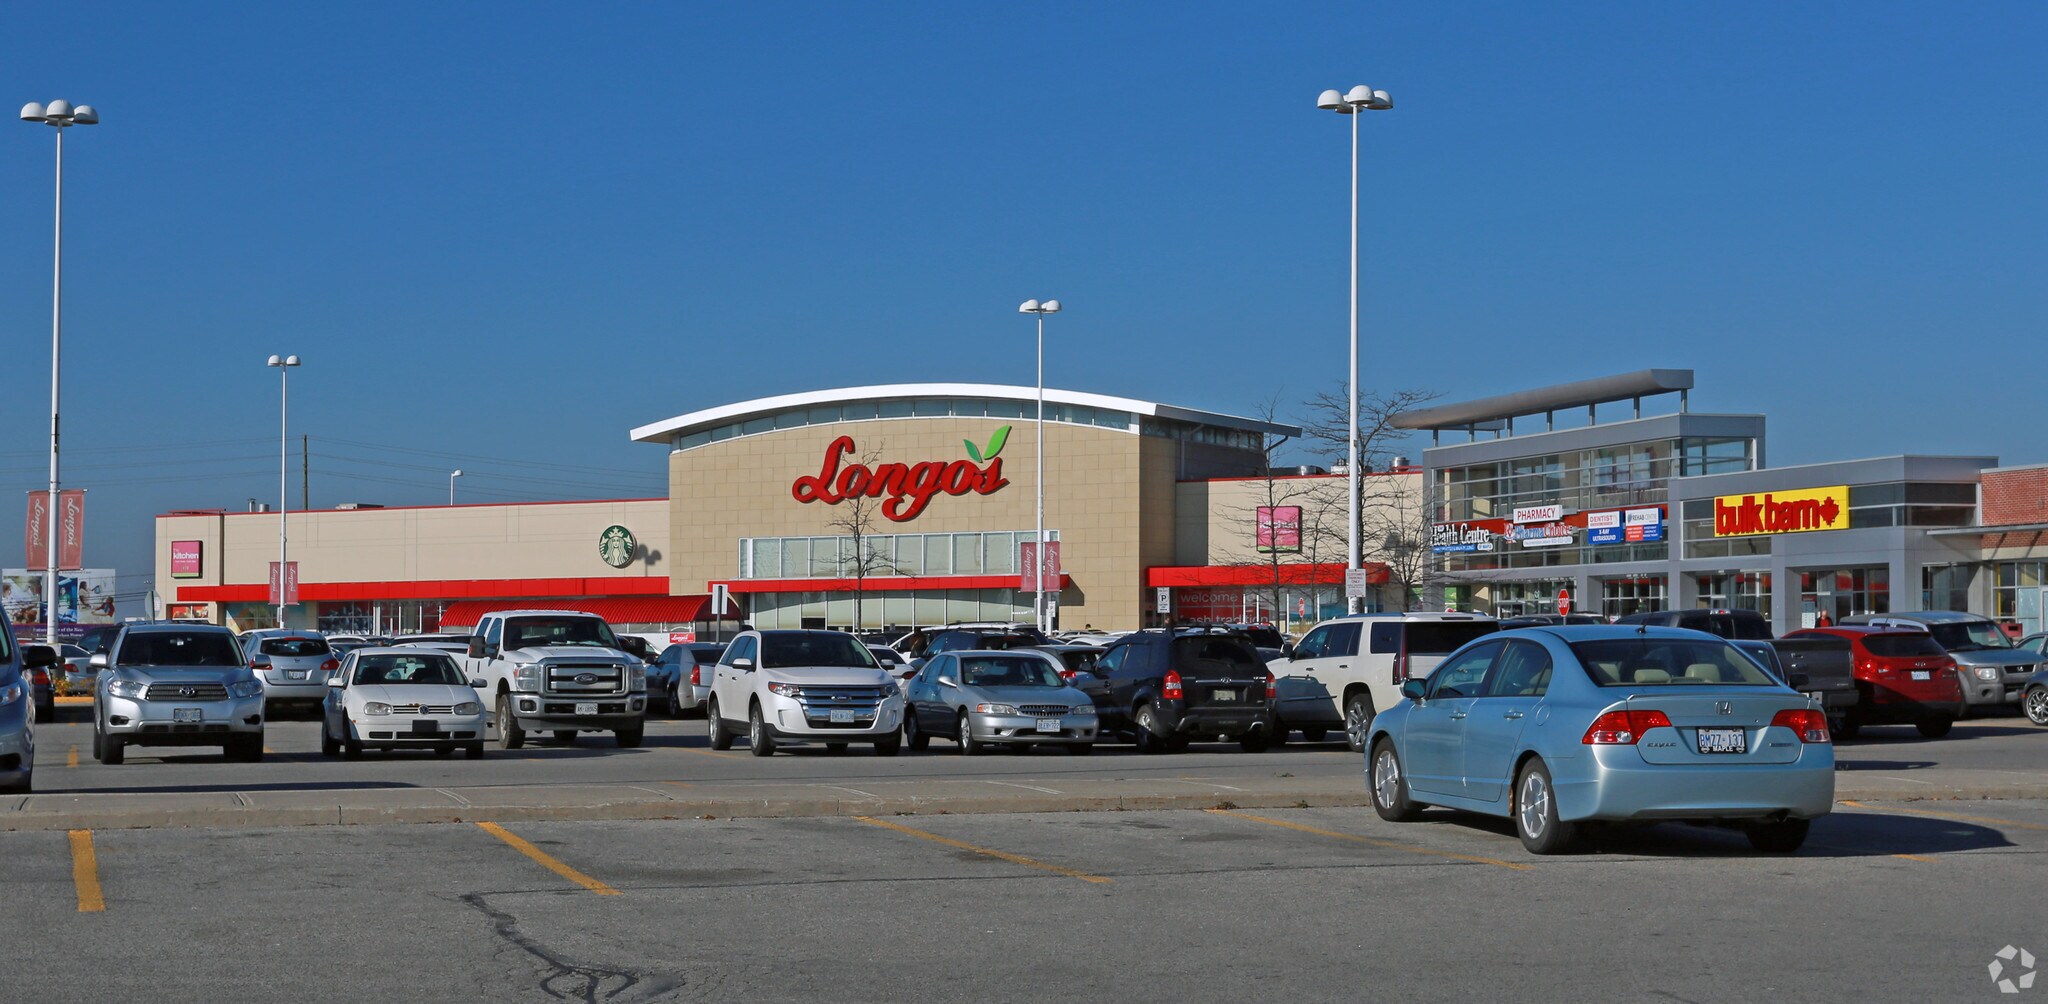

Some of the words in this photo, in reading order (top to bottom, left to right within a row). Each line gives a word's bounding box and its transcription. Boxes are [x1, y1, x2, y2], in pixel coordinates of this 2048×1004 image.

[1517, 507, 1556, 520] PHARMACY
[1589, 515, 1613, 523] DENTIST
[1716, 498, 1764, 535] bulk
[1765, 494, 1820, 532] barn
[1460, 522, 1490, 544] Centre
[173, 552, 199, 560] kitchen
[1181, 592, 1238, 603] welcome
[1558, 598, 1569, 608] STOP
